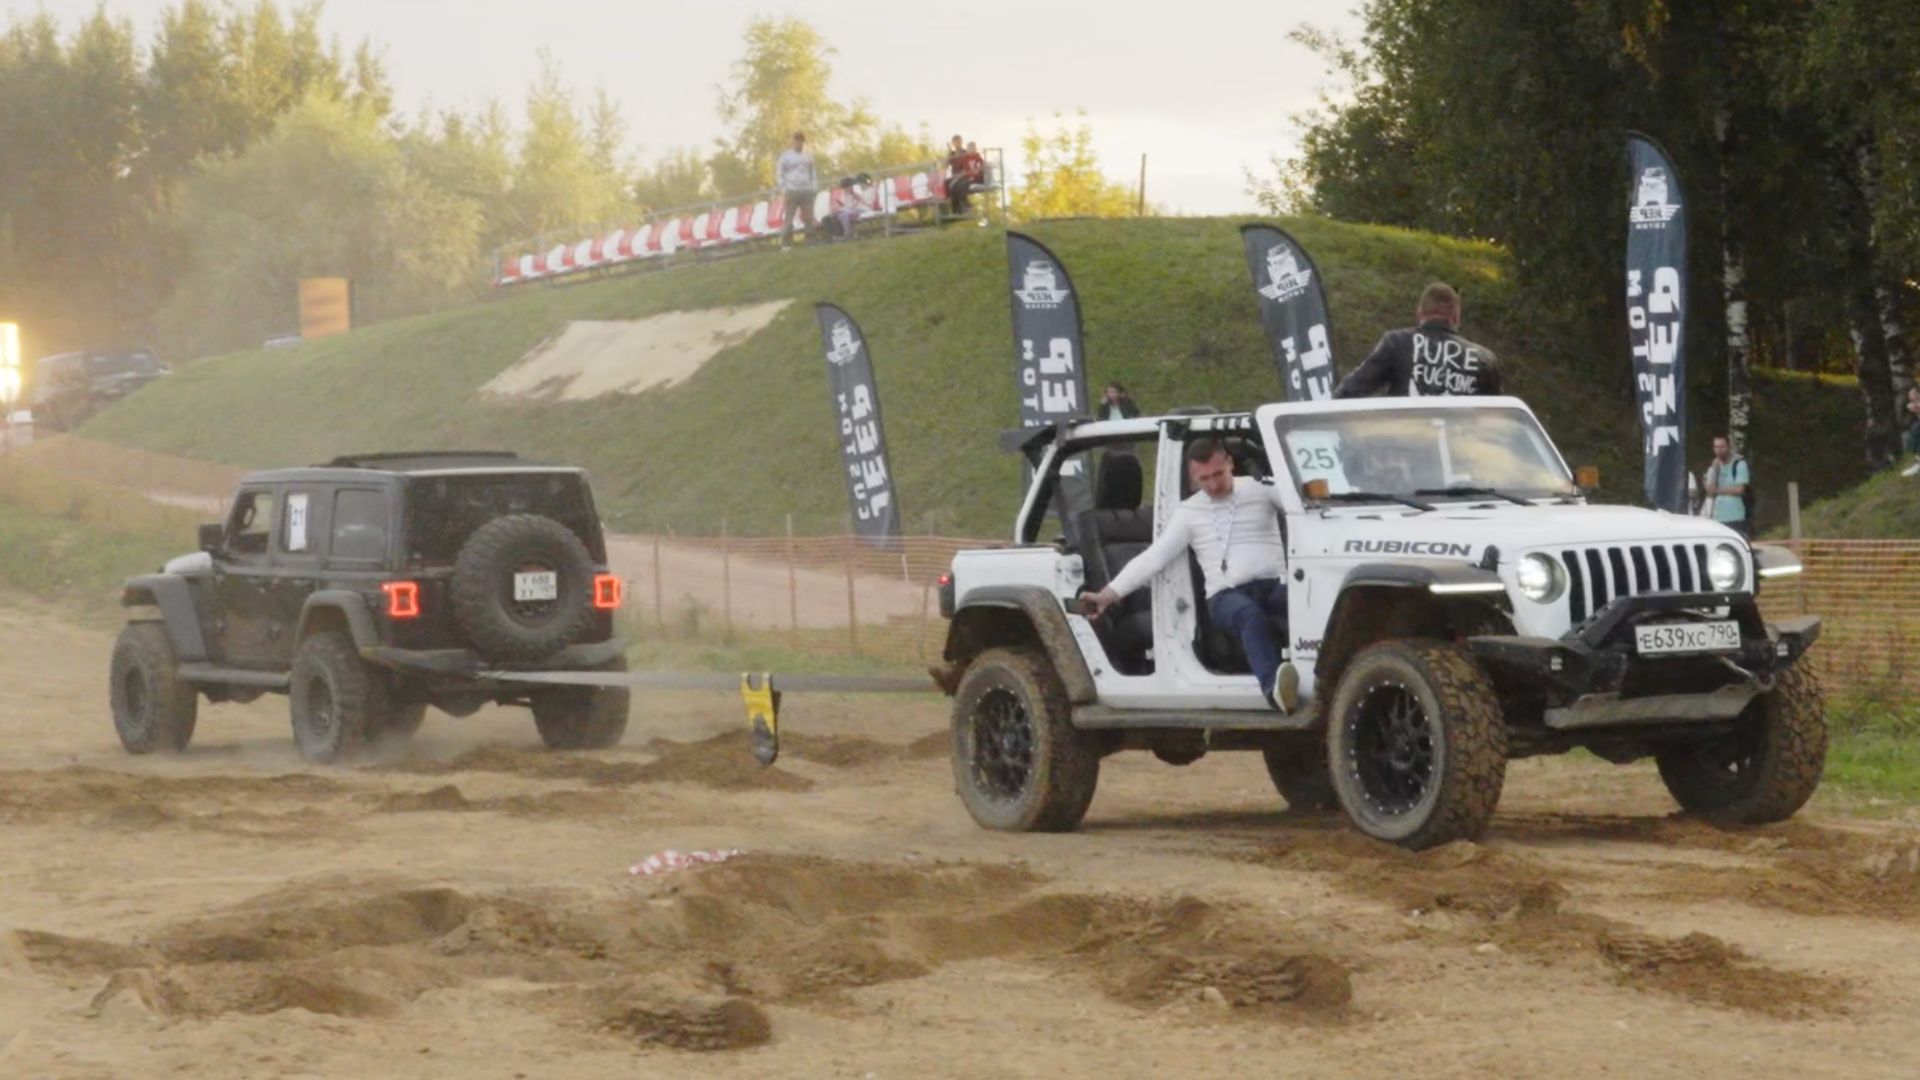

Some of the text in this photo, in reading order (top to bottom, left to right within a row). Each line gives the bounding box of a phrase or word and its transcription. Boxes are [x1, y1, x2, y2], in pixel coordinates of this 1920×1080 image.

[1413, 333, 1478, 371] PURE
[1297, 447, 1335, 470] 25
[1344, 539, 1472, 556] RUBICON
